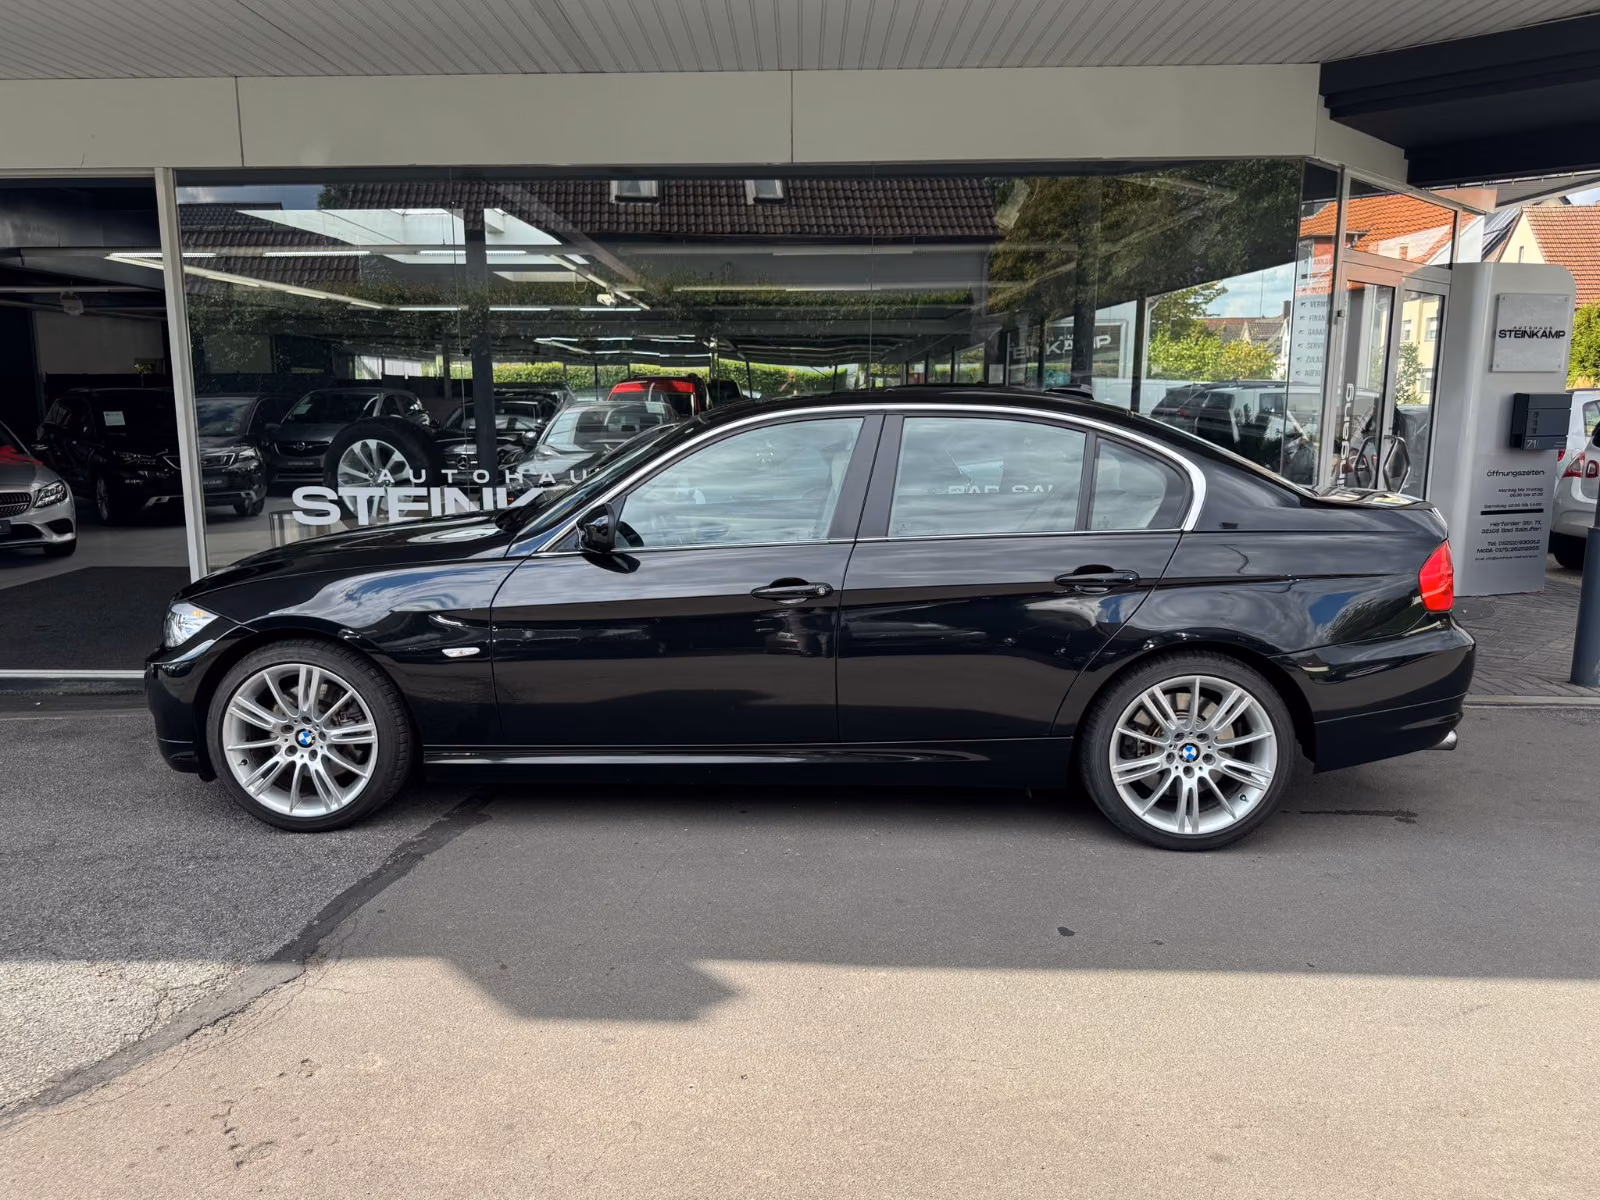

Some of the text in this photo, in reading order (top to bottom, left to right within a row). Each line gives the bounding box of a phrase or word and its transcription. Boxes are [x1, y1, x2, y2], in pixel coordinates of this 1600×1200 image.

[1498, 329, 1566, 339] STEINKAMP
[1336, 383, 1354, 488] ingang
[1526, 439, 1537, 448] 71
[377, 468, 599, 484] AUTOHAU
[1486, 469, 1545, 477] Öffnungszeiten
